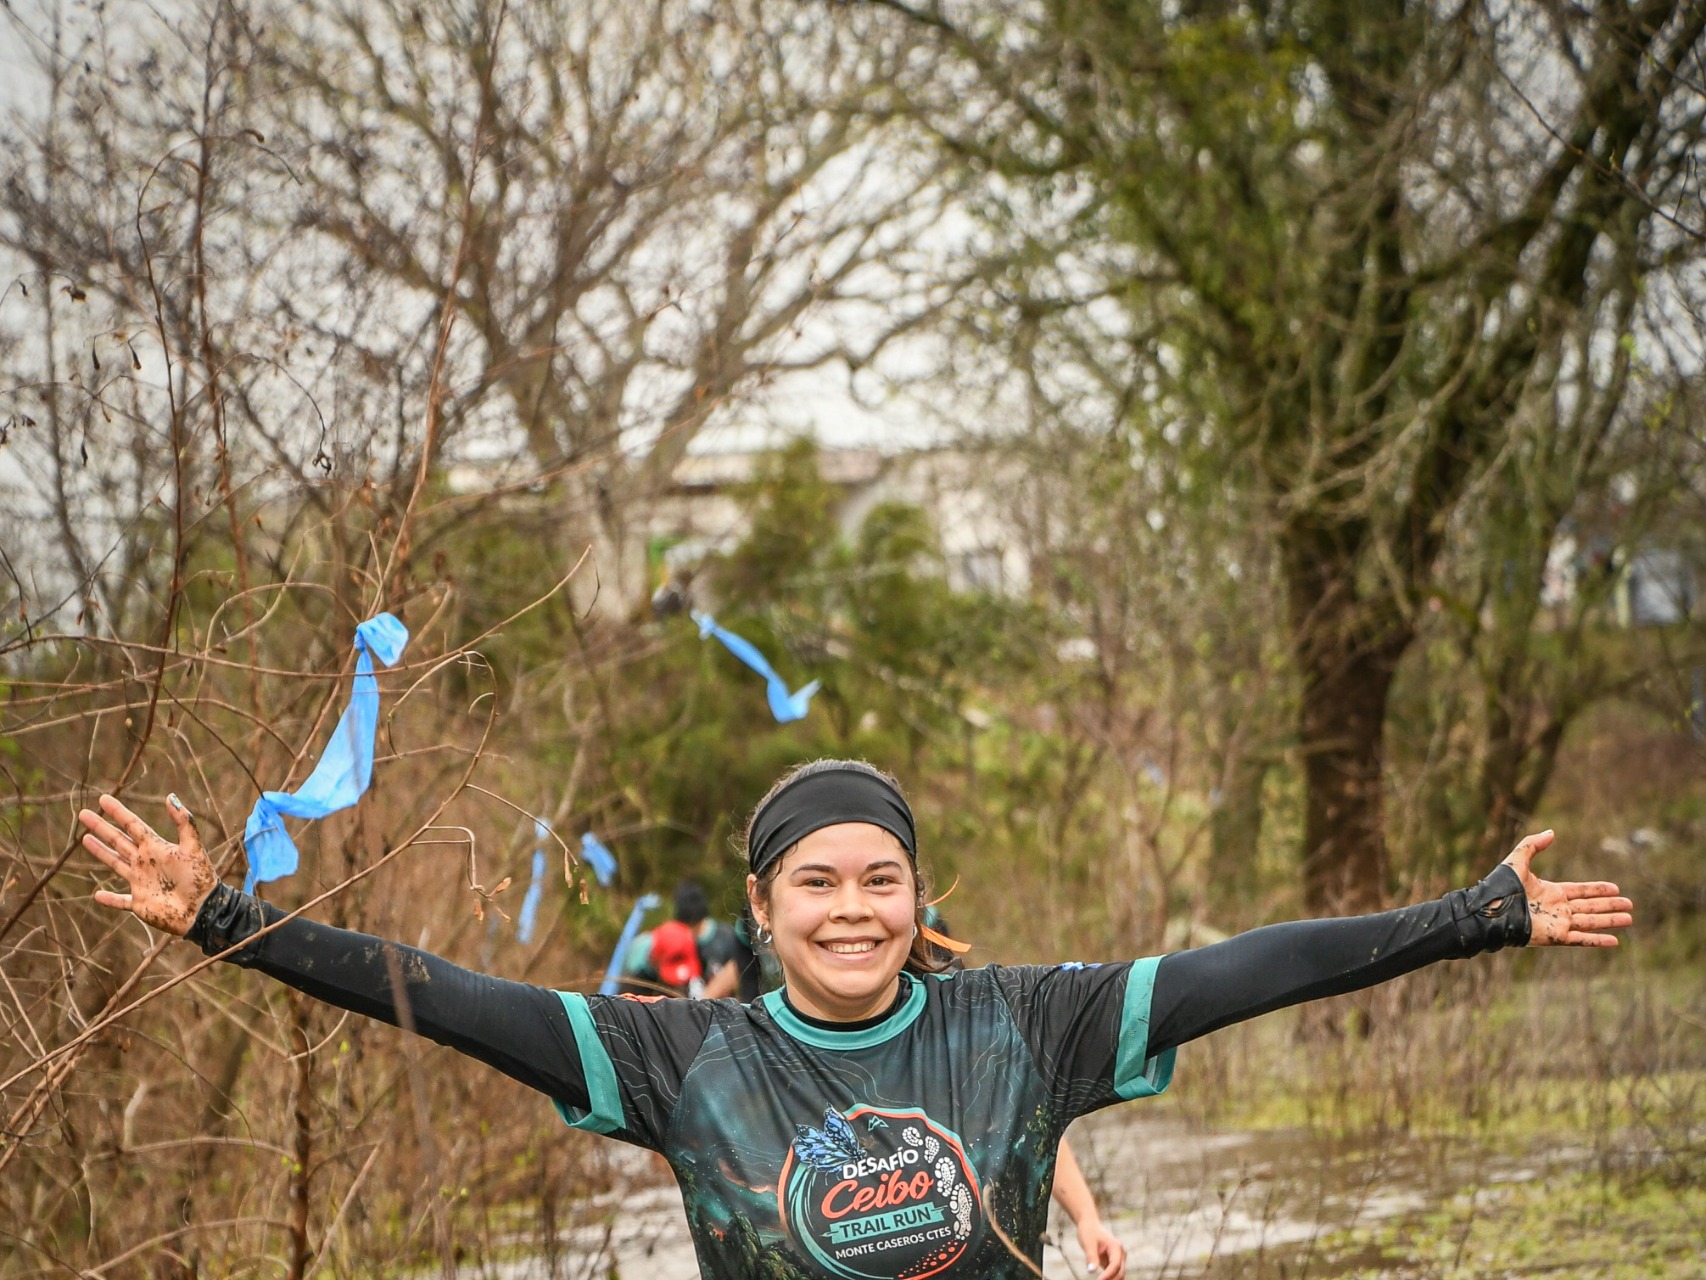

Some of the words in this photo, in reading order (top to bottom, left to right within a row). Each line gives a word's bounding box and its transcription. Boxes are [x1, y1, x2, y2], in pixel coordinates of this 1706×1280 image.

[842, 1147, 919, 1180] DESAFÍO
[821, 1169, 934, 1219] Ceibo
[839, 1217, 890, 1239] TRAIL
[895, 1206, 931, 1227] RUN
[835, 1244, 875, 1260] MONTE
[876, 1234, 925, 1252] CASEROS
[927, 1226, 951, 1241] CTES
